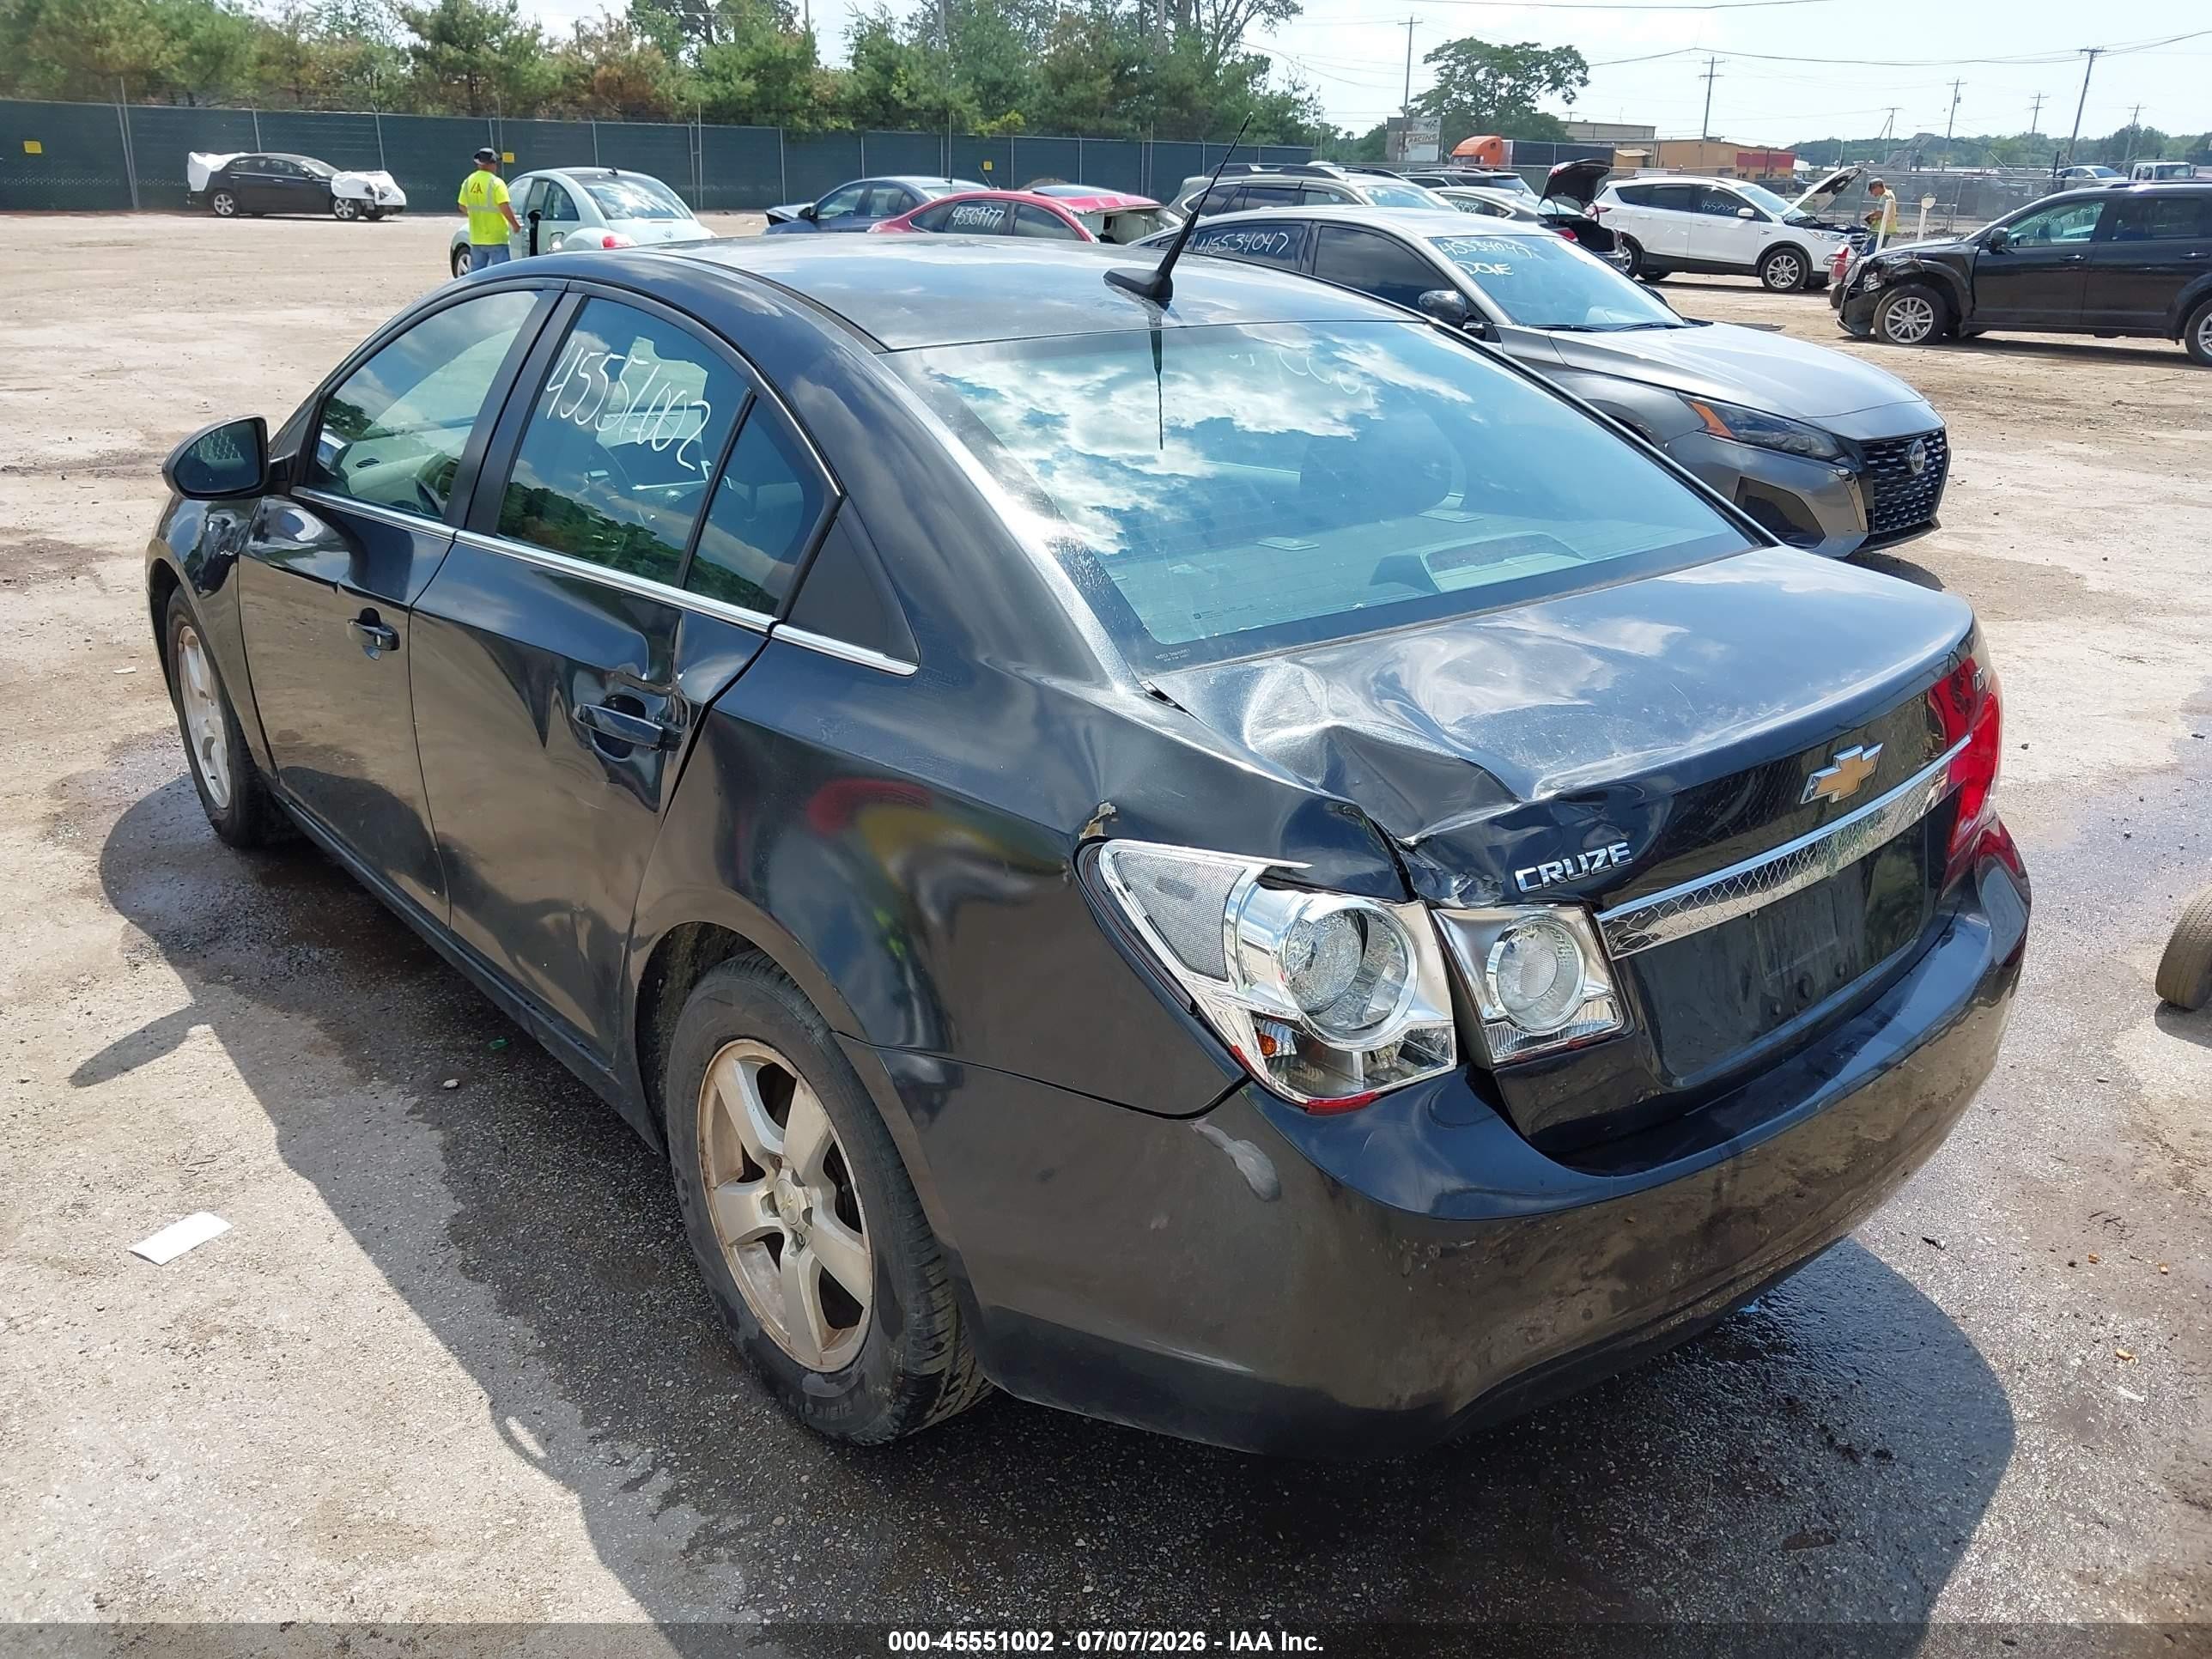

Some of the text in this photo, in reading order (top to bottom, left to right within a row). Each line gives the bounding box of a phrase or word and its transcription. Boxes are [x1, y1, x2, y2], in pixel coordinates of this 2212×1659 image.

[1198, 233, 1289, 255] 45534047
[545, 340, 711, 471] 45551002
[1515, 842, 1633, 893] CRUZE
